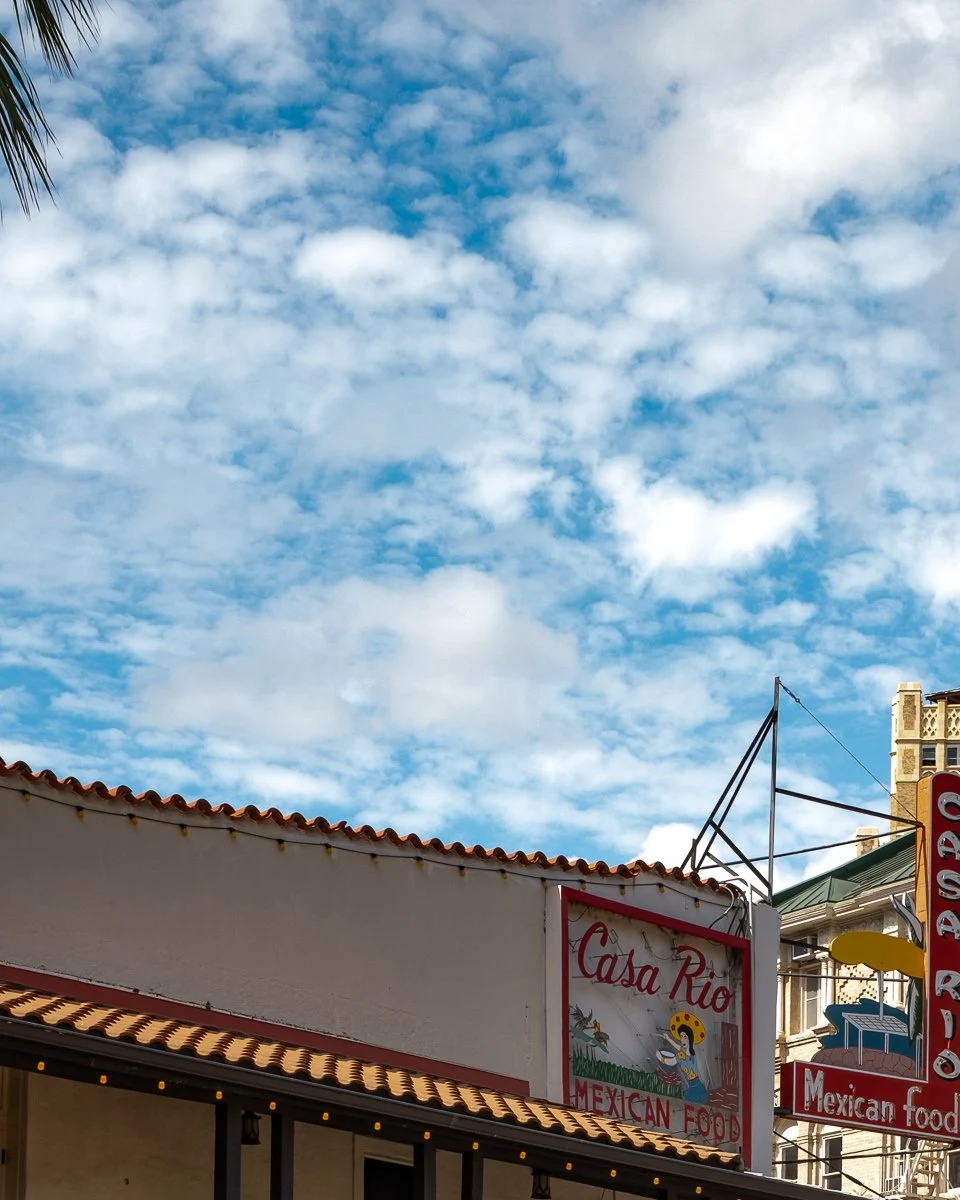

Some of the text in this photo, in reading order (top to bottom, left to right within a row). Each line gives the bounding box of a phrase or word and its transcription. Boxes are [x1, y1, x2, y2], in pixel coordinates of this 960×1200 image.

[577, 921, 735, 1014] Casa Rio
[573, 1078, 742, 1144] MEXICAN FOOD
[803, 1068, 960, 1134] Mexican food
